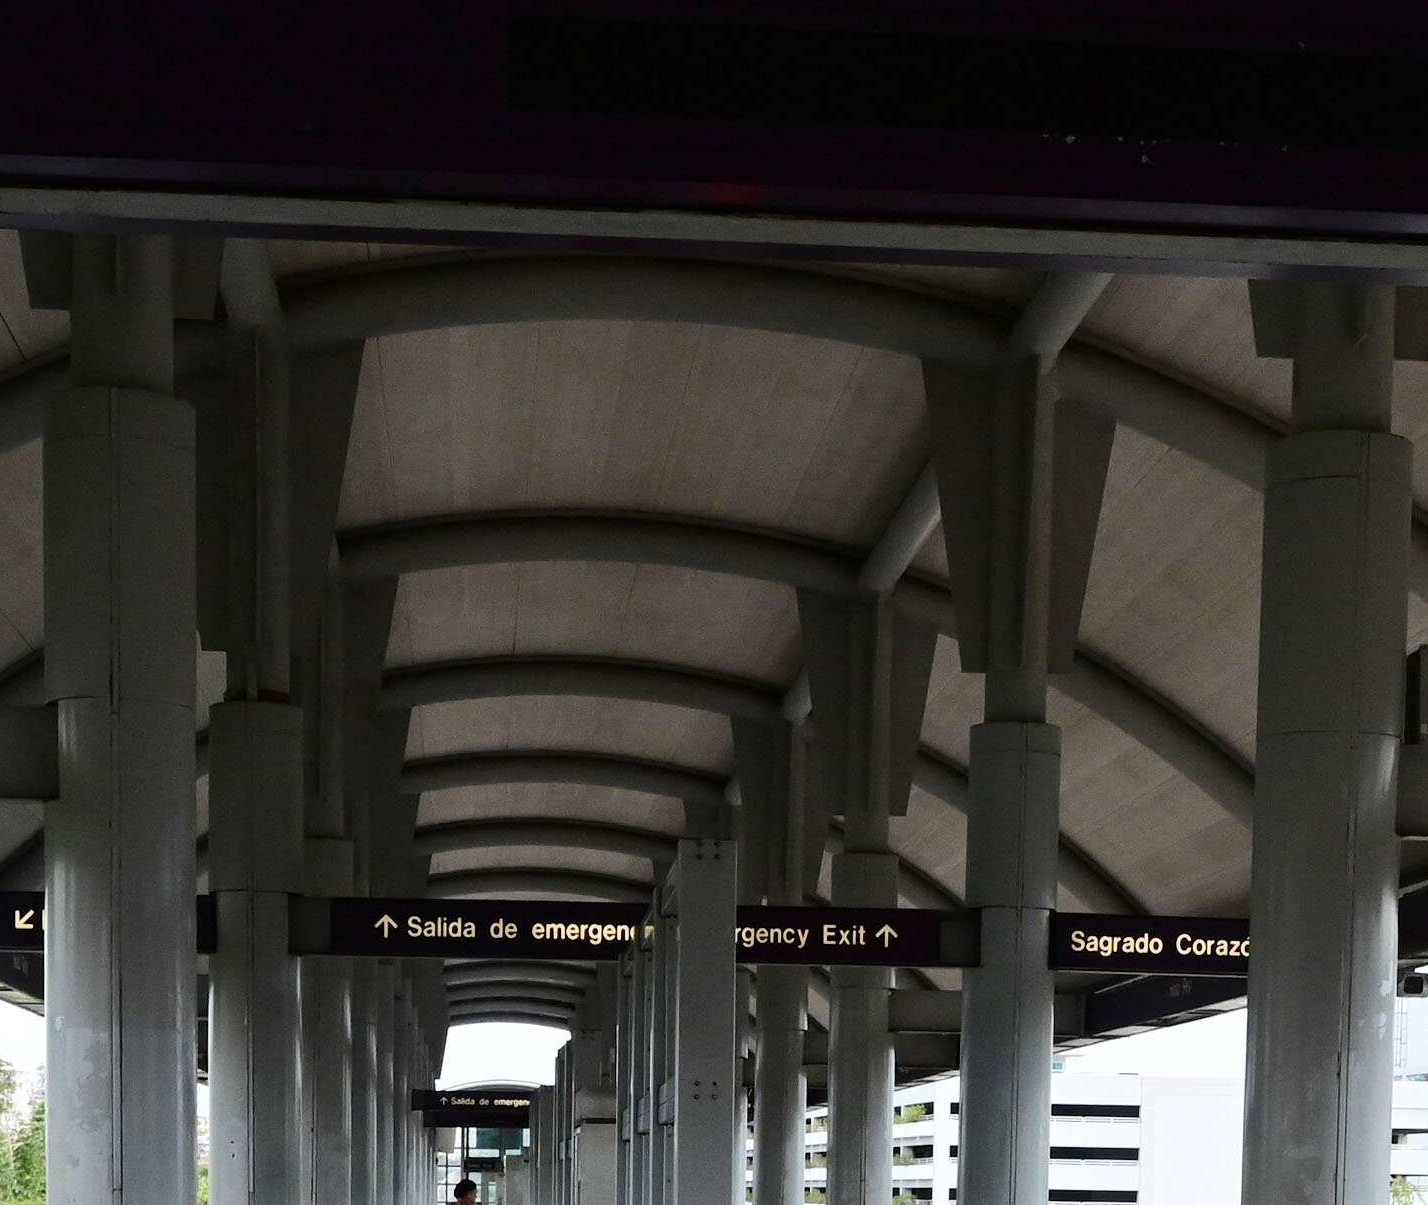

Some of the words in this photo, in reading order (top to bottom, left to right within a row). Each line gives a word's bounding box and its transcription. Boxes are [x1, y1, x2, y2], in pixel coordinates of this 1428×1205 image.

[407, 915, 476, 939] Salida
[489, 918, 518, 939] de
[531, 921, 635, 946] emergen
[734, 926, 810, 949] rgency
[822, 923, 867, 945] Exit
[1071, 930, 1164, 957] Sagrado
[1175, 933, 1251, 957] Corazó
[451, 1096, 475, 1105] Salida
[479, 1098, 489, 1106] de
